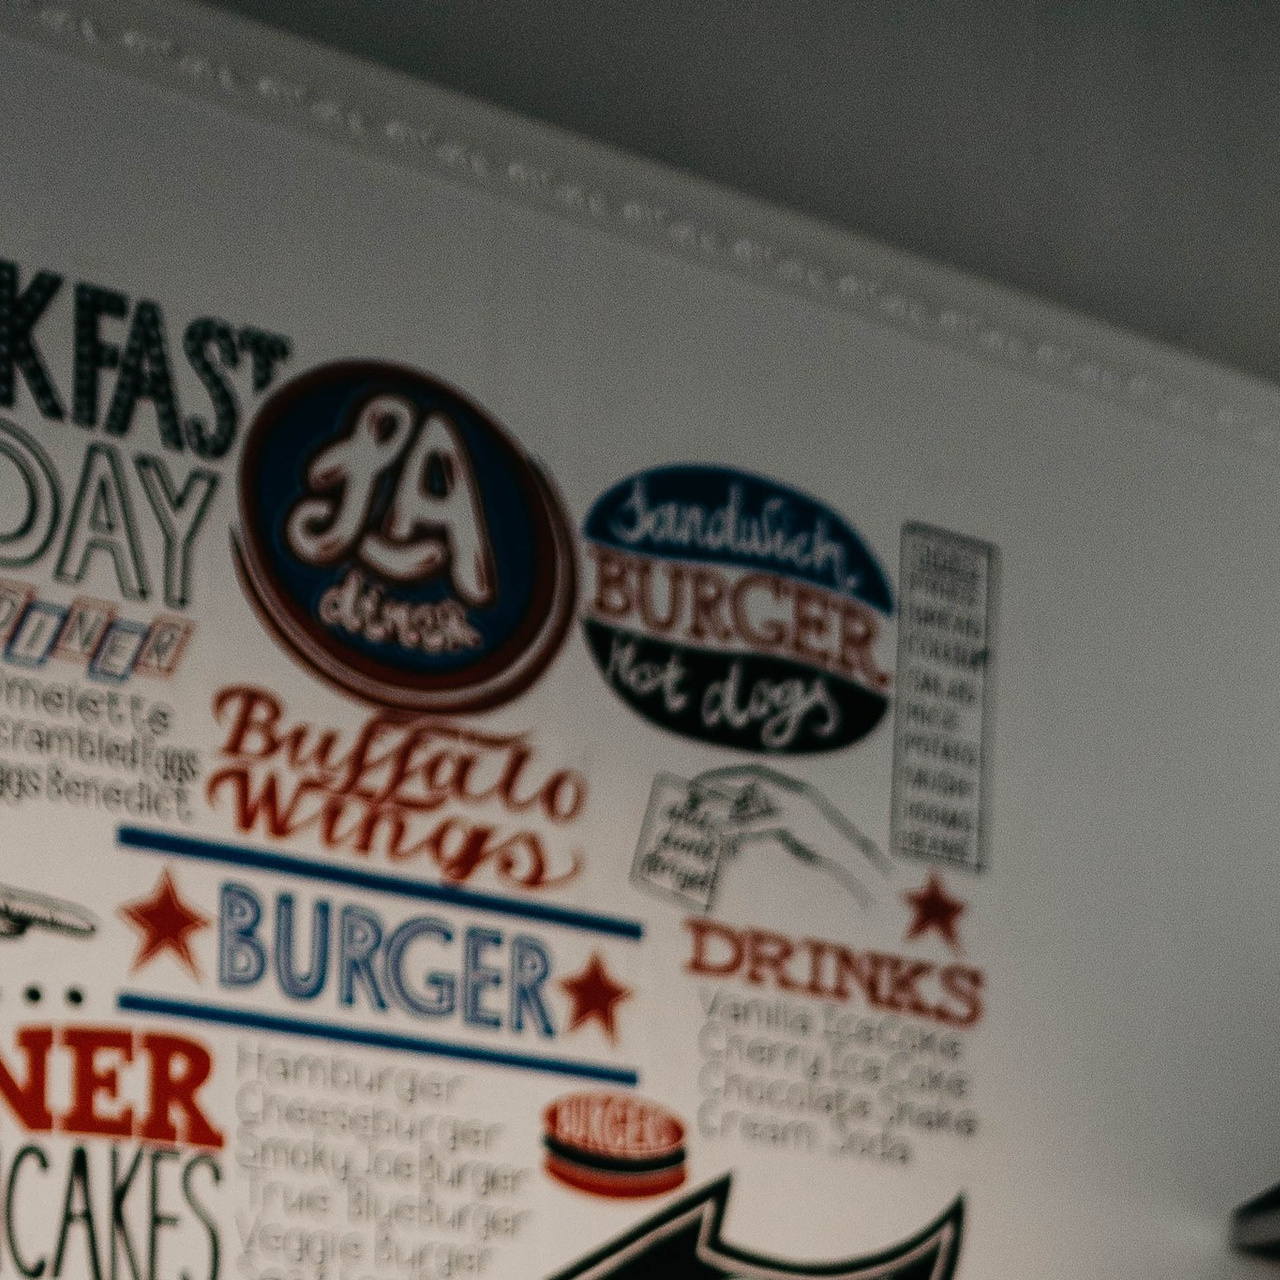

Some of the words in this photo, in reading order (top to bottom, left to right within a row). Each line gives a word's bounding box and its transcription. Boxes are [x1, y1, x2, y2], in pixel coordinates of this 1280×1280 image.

[590, 548, 890, 690] BURGER
[211, 684, 588, 824] Buffalo
[605, 636, 690, 714] Hot
[703, 662, 840, 747] dogs
[207, 765, 583, 889] Wings
[218, 879, 556, 1040] BURGER
[685, 917, 985, 1029] DRINKS
[0, 1022, 226, 1149] NER
[234, 1037, 468, 1106] Hamburger
